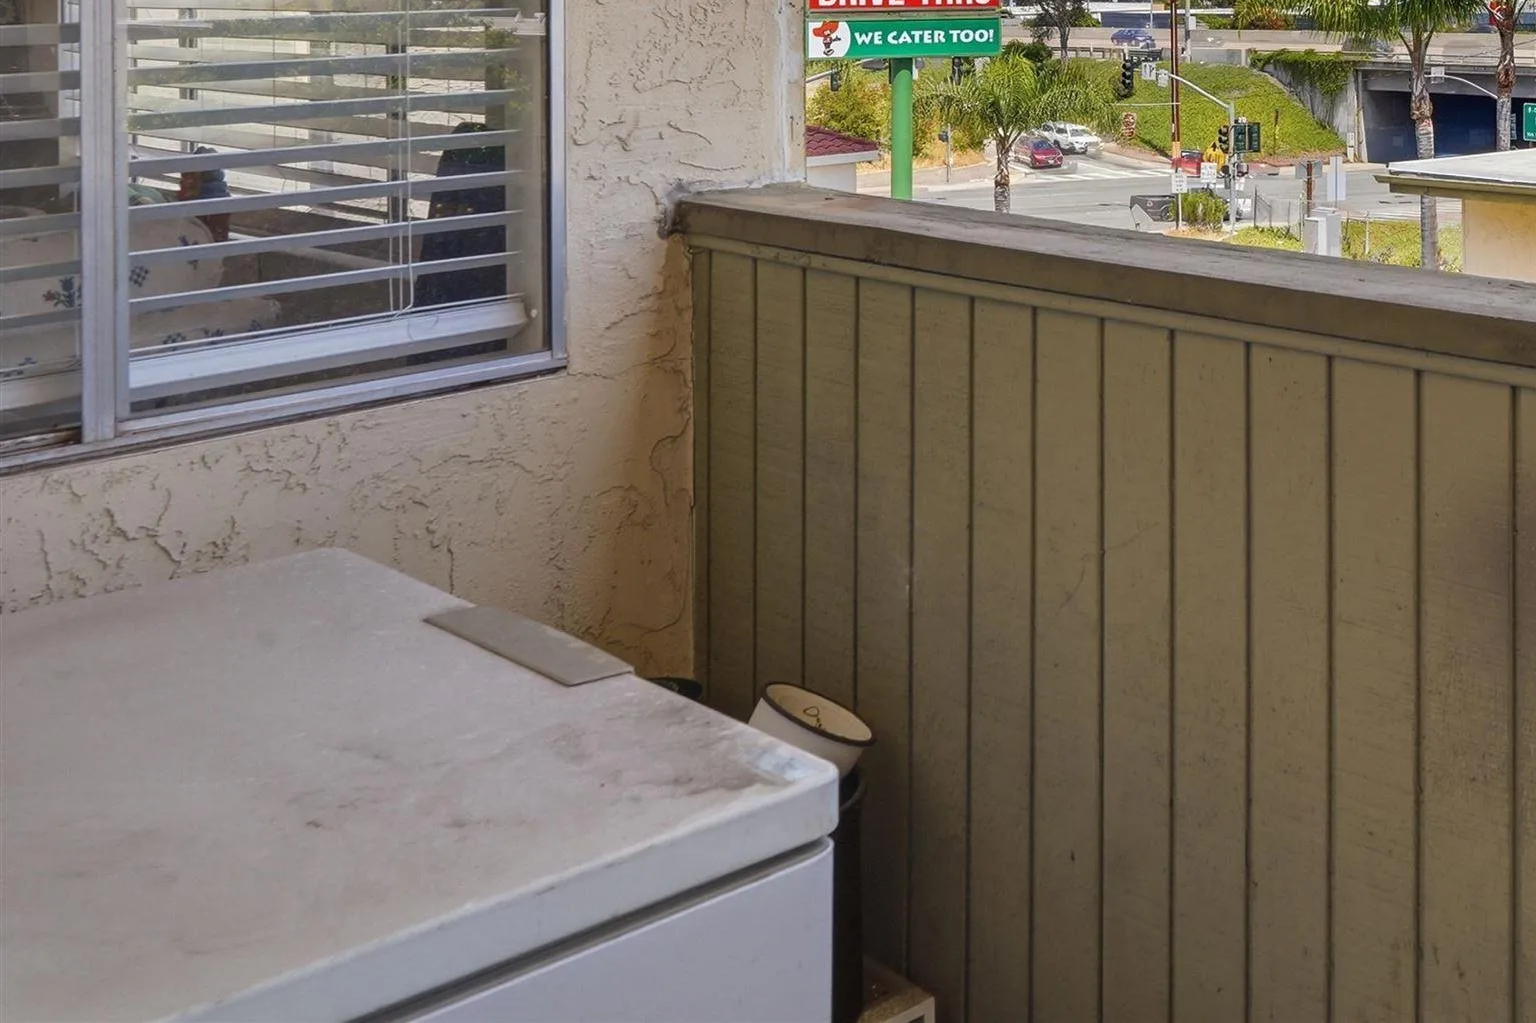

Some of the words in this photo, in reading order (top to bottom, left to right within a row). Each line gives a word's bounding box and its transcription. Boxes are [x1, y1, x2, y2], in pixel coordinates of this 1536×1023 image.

[854, 31, 883, 46] WE
[887, 30, 946, 45] CATER
[949, 29, 994, 43] TOO!
